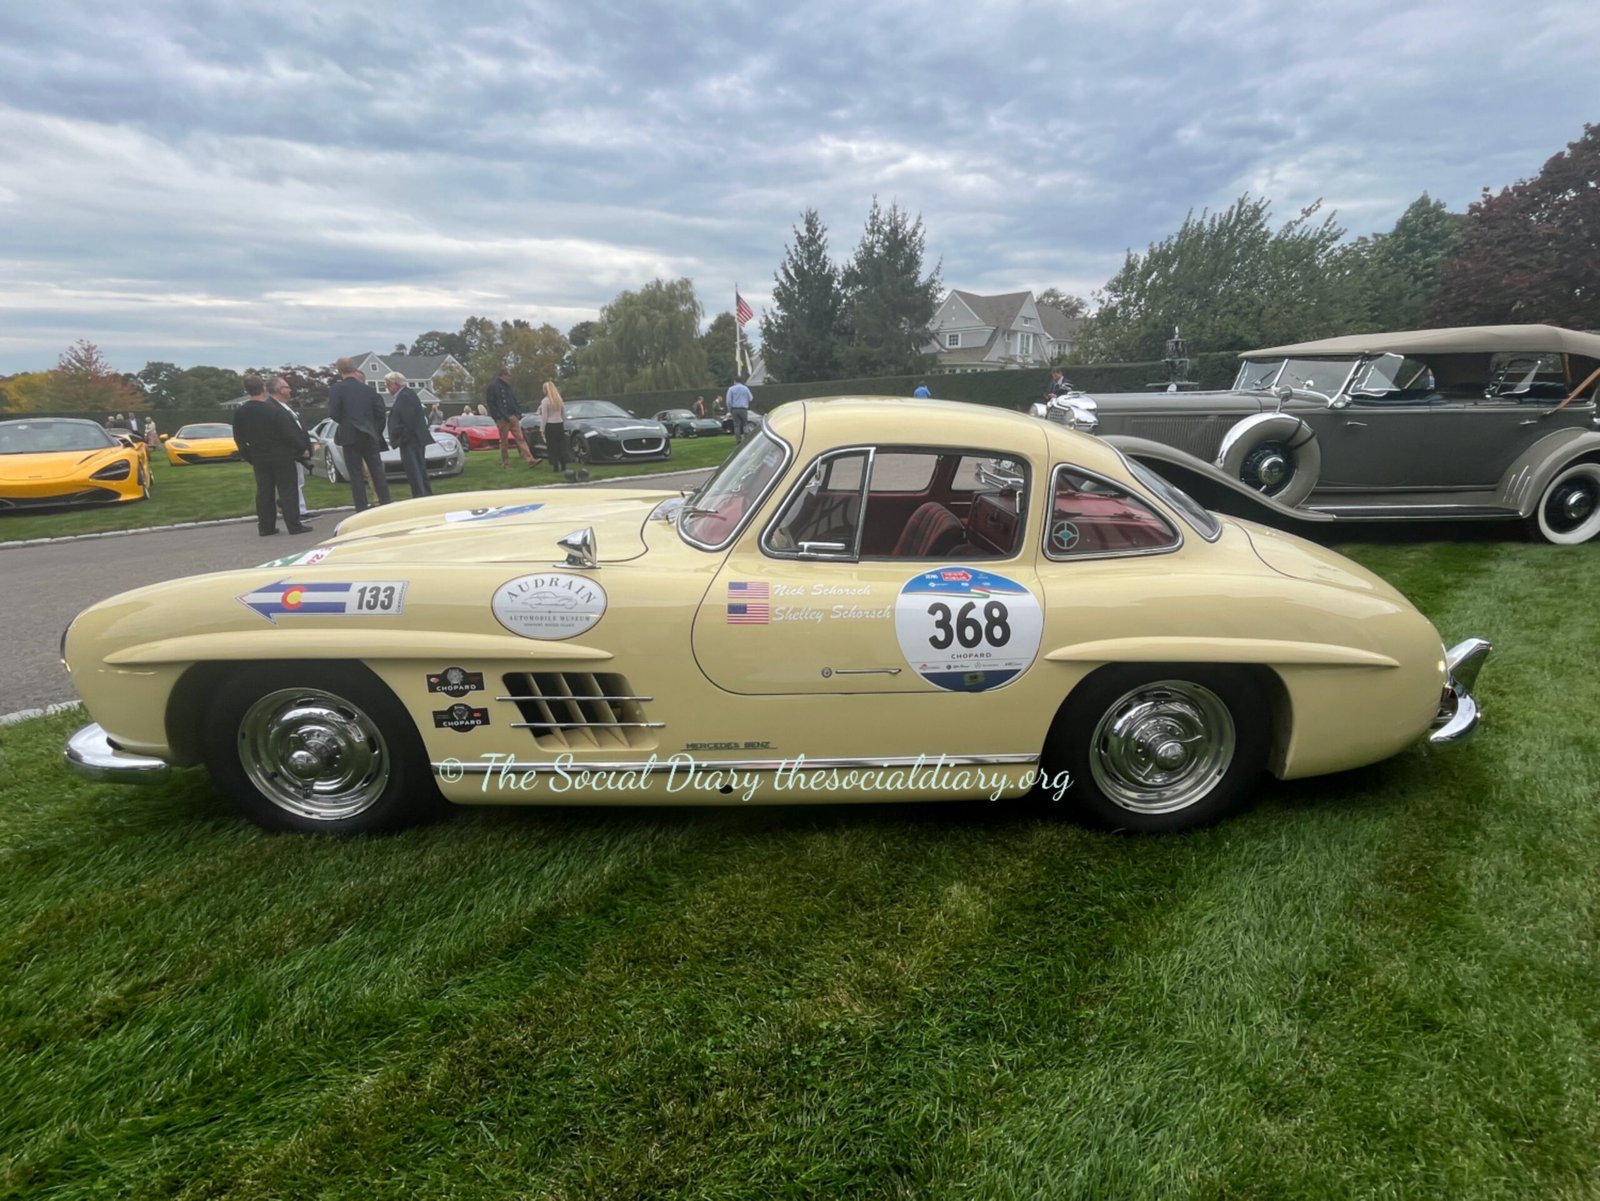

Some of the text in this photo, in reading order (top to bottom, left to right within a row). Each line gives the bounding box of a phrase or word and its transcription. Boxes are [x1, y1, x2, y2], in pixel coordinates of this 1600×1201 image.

[507, 577, 596, 604] AUDRAIN
[773, 584, 872, 597] Nick Schorsch
[357, 585, 396, 611] 133
[772, 604, 892, 624] Shelley Schorsch
[927, 601, 1011, 650] 368
[951, 652, 992, 660] CHOPARD
[436, 684, 477, 692] CHOPARD
[442, 719, 482, 727] CHOPARD
[686, 741, 771, 750] MERCEDES BENZ
